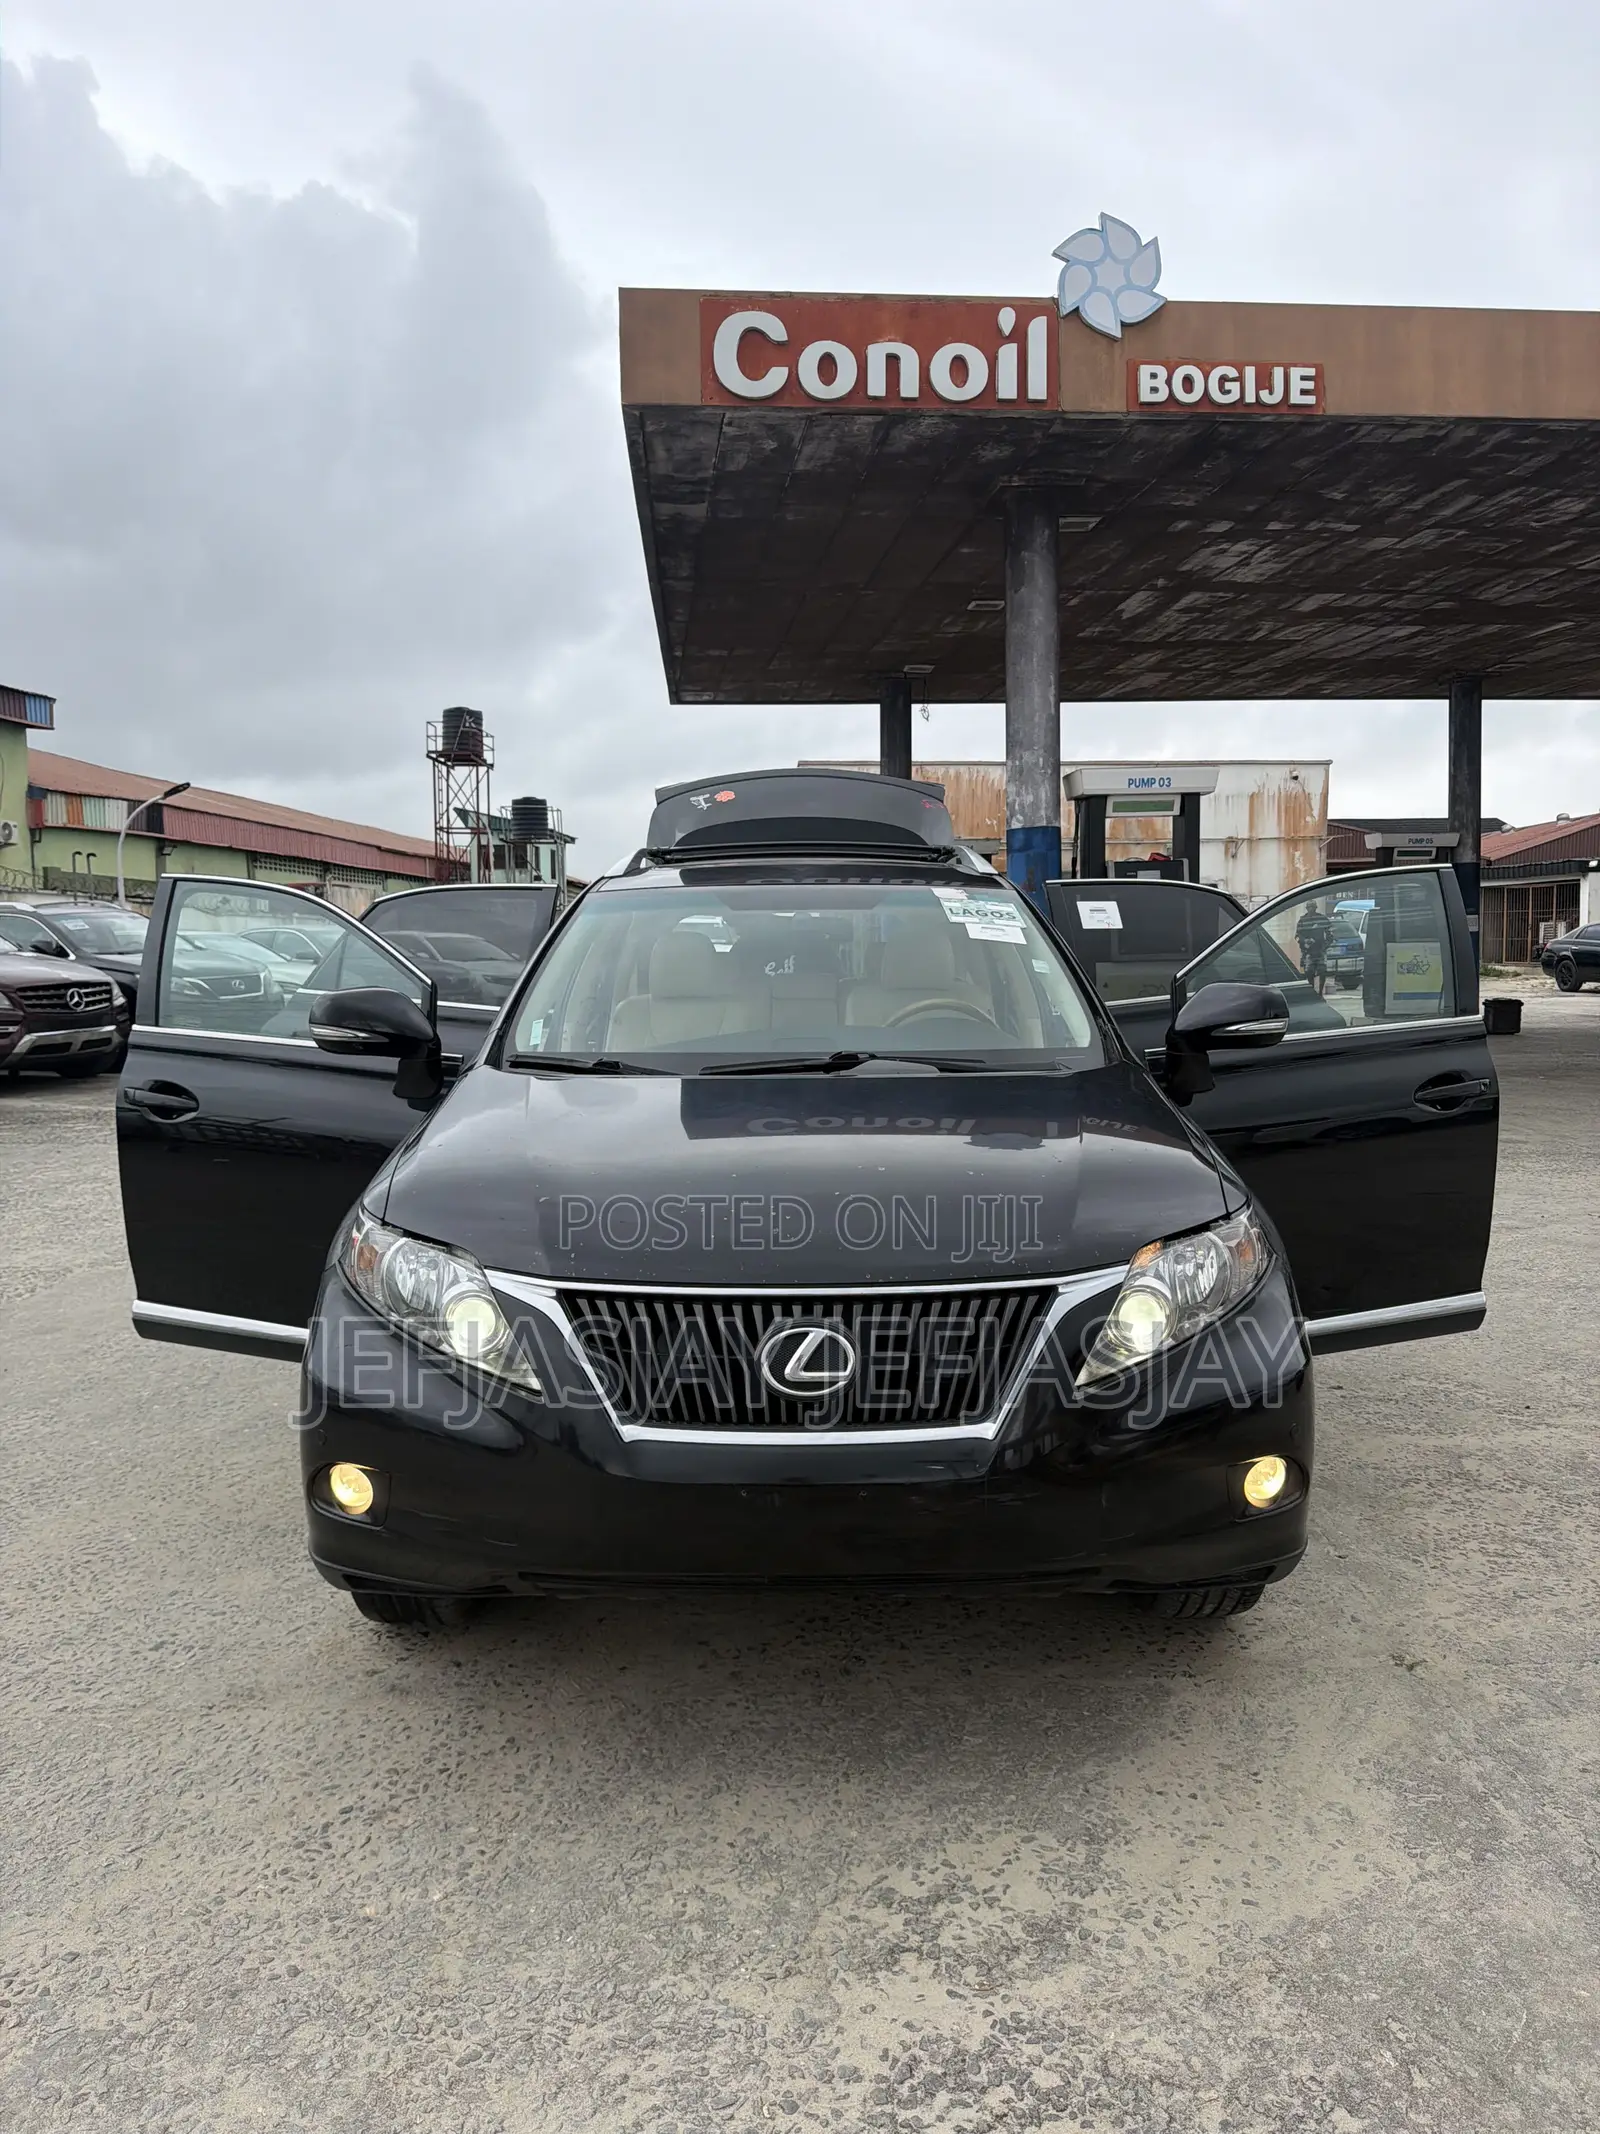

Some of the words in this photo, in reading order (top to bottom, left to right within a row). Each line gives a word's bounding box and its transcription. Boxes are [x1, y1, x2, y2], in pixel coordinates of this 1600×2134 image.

[712, 307, 1049, 402] Conoil
[1138, 363, 1317, 407] BOGIJE
[1127, 778, 1156, 789] PUMP
[1158, 777, 1172, 788] 03
[1408, 837, 1425, 845] PUMP
[949, 907, 1017, 921] LAGOS
